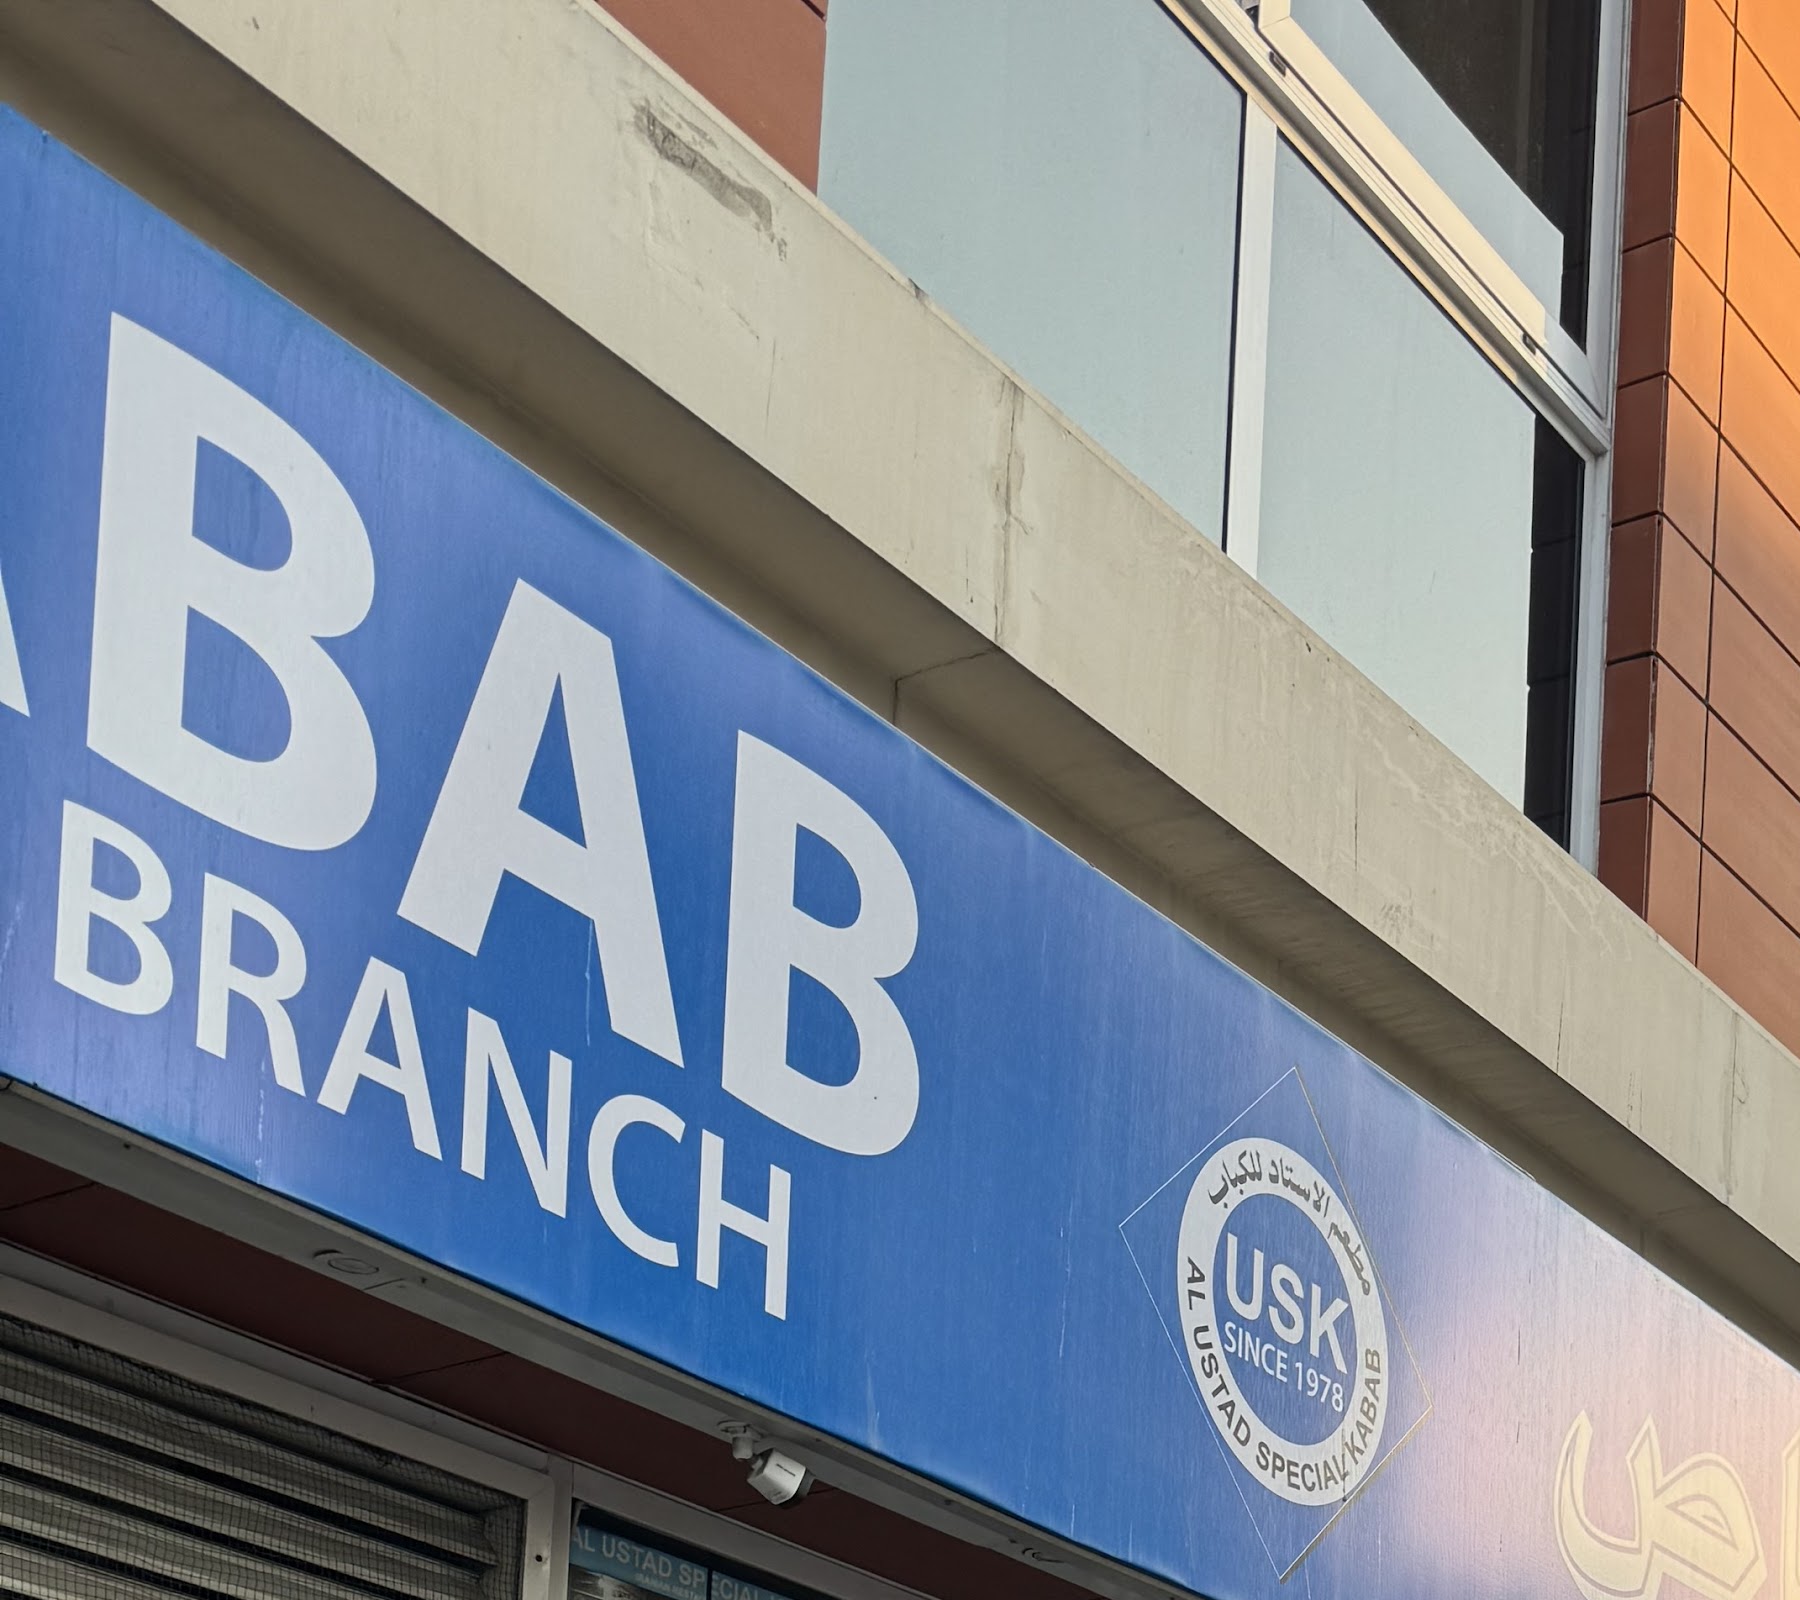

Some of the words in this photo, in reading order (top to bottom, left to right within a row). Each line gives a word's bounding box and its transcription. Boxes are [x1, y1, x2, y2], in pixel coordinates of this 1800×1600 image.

[0, 311, 920, 1156] BAB
[54, 801, 791, 1321] BRANCH
[1187, 1257, 1206, 1311] AL
[1226, 1232, 1349, 1374] USK
[1193, 1325, 1251, 1447] USTAD
[1224, 1321, 1287, 1383] SINCE
[1295, 1361, 1344, 1413] 1978
[1345, 1348, 1381, 1465] KABAB
[1256, 1441, 1349, 1492] SPECIAL
[572, 1528, 595, 1552] AL
[602, 1535, 672, 1578] USTAD
